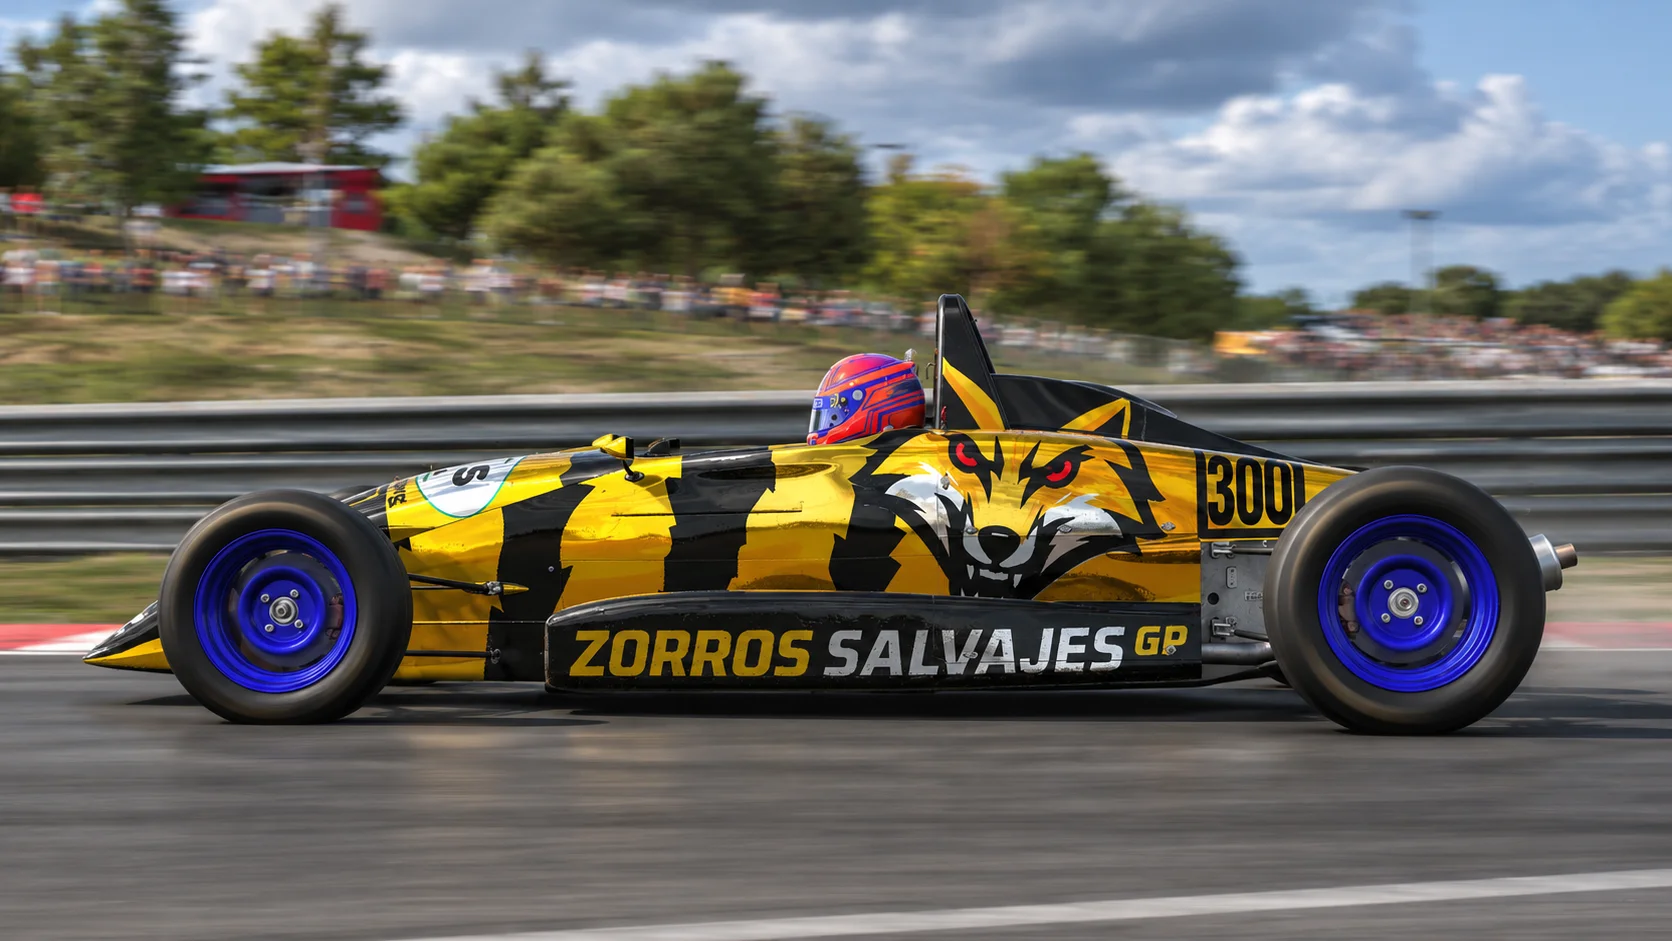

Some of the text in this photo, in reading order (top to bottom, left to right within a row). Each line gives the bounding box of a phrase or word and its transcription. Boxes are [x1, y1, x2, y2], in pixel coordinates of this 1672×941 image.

[1207, 455, 1293, 526] 300
[569, 625, 1188, 677] ZORROS SALVAJES GP
